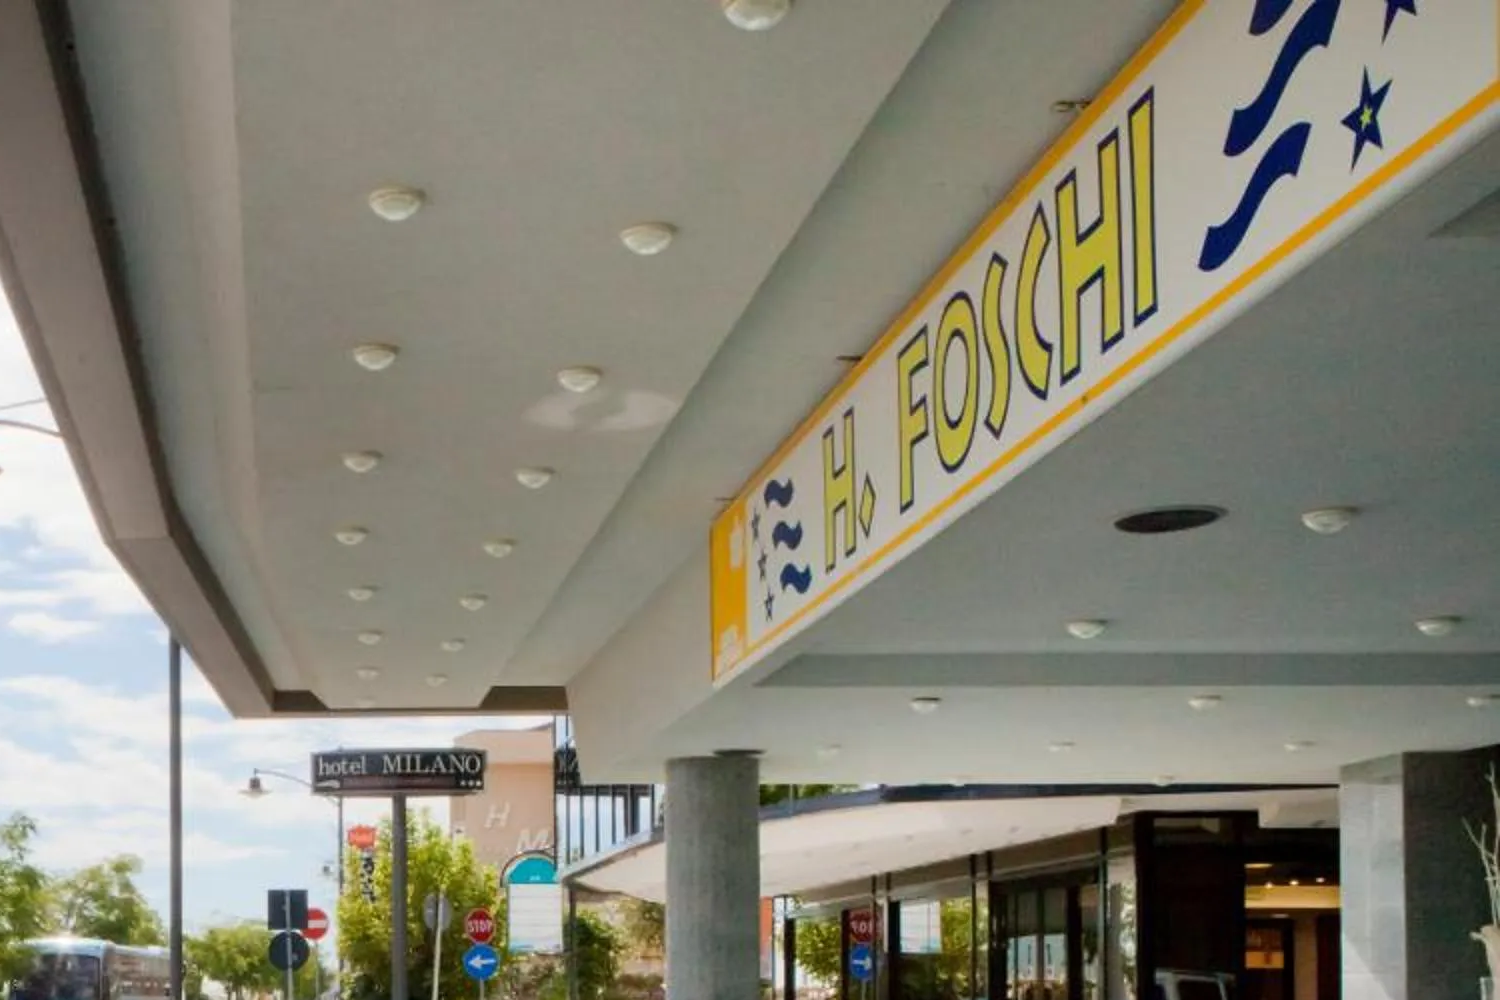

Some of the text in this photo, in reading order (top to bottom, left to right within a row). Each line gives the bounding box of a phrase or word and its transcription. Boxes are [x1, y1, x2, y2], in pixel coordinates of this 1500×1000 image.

[897, 84, 1159, 515] FOSCHI
[318, 753, 481, 775] hotel MILANO
[467, 918, 493, 933] STOP
